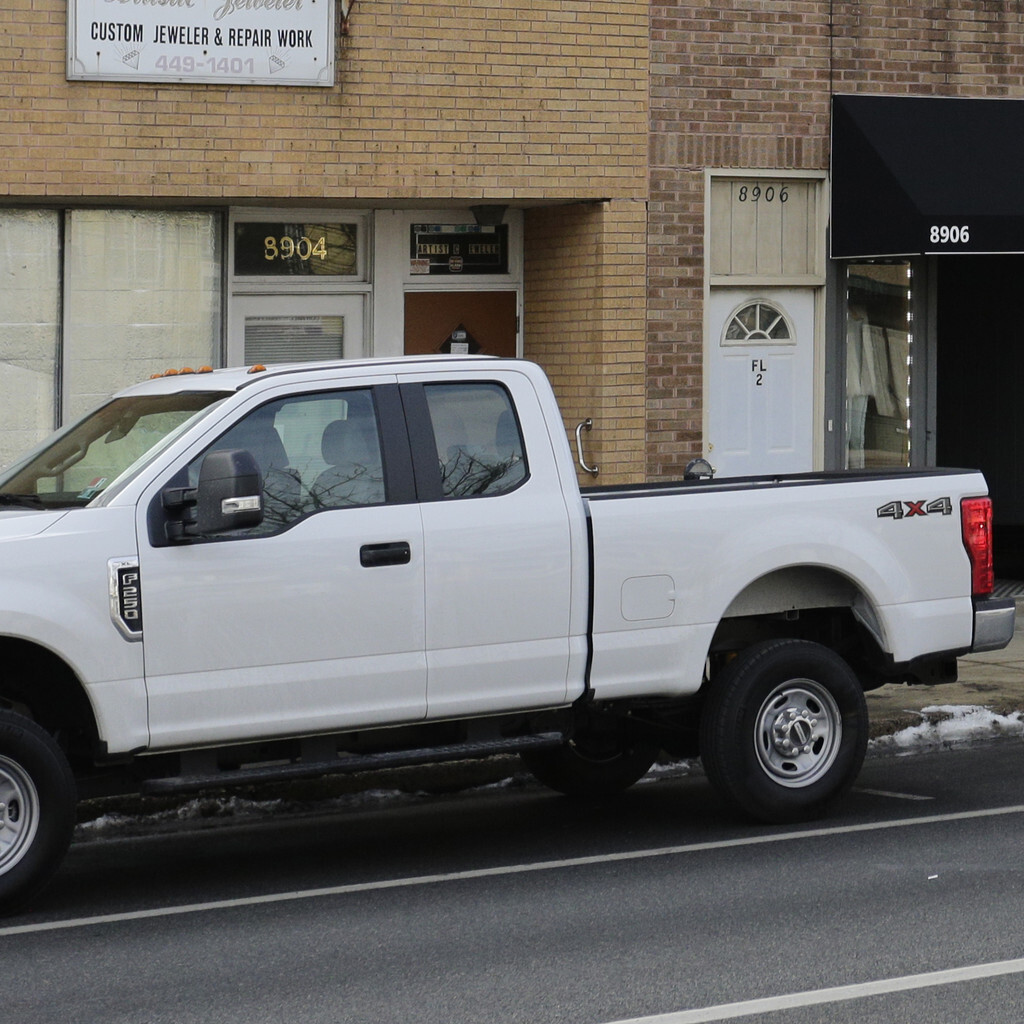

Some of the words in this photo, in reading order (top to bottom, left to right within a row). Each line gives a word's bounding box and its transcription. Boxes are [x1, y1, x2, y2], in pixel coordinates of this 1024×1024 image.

[91, 21, 144, 43] CUSTOM
[153, 25, 209, 46] JEWELER
[214, 28, 223, 46] &
[228, 28, 272, 47] REPAIR
[277, 29, 313, 48] WORK
[155, 55, 255, 74] 449-1401
[739, 186, 789, 203] 8906
[929, 225, 970, 244] 8906
[264, 236, 327, 260] 8904
[751, 359, 767, 372] FL
[755, 374, 763, 387] 2
[122, 573, 139, 620] F250
